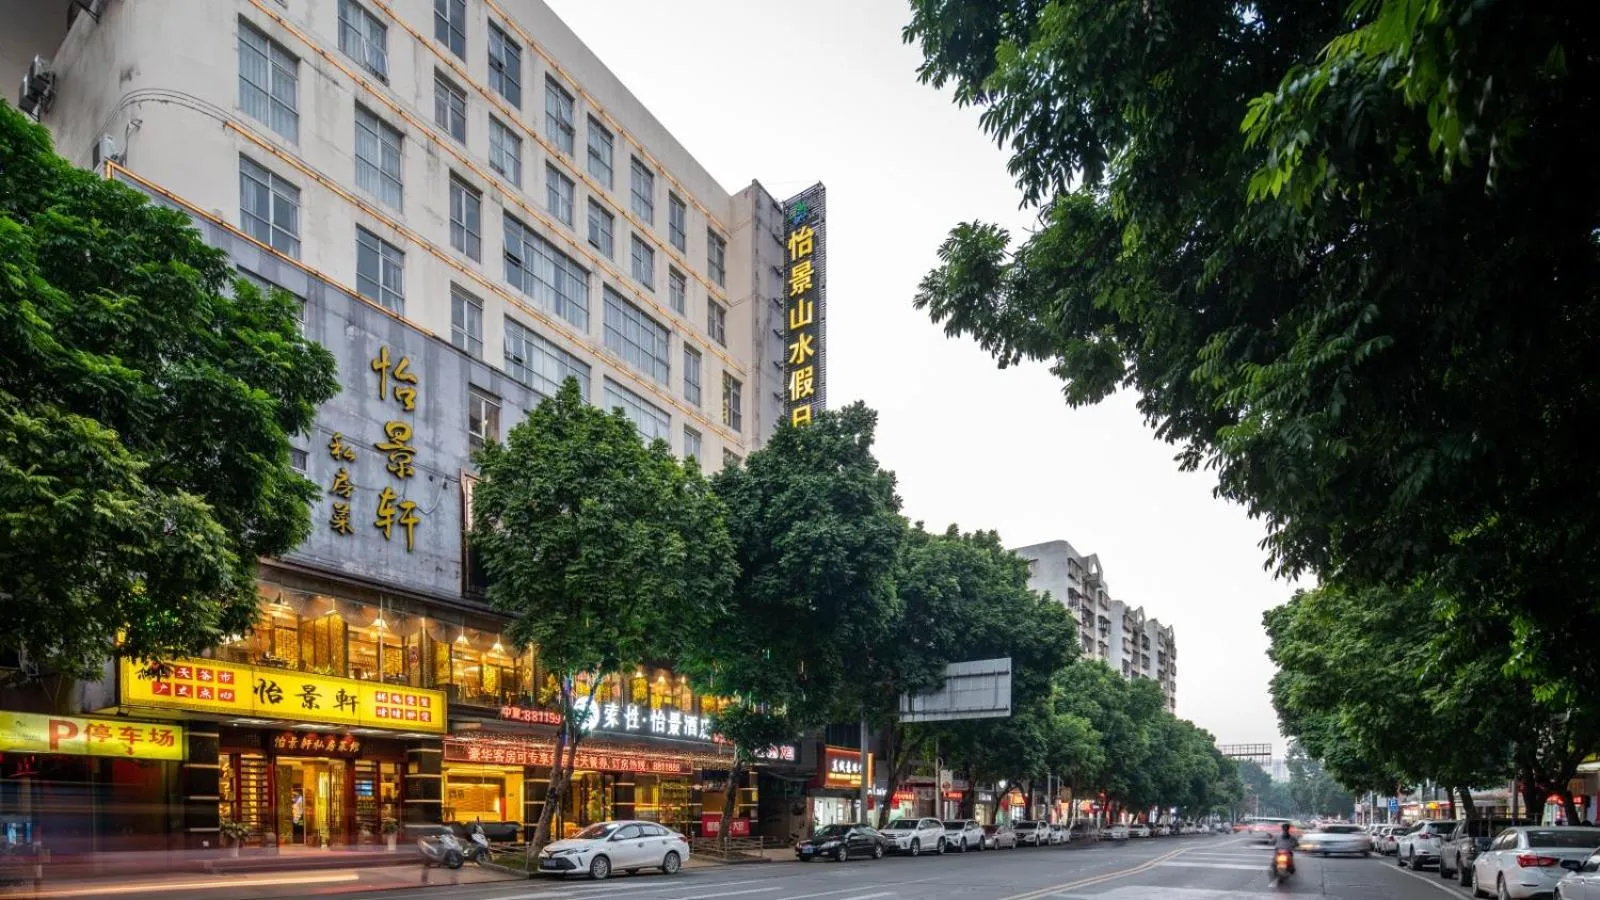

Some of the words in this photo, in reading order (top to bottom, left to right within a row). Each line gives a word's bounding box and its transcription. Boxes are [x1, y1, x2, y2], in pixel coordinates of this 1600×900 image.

[788, 226, 815, 427] 怡景山水假日
[328, 431, 357, 535] 私房菜
[371, 345, 421, 551] 怡景轩
[84, 723, 174, 748] 停车场
